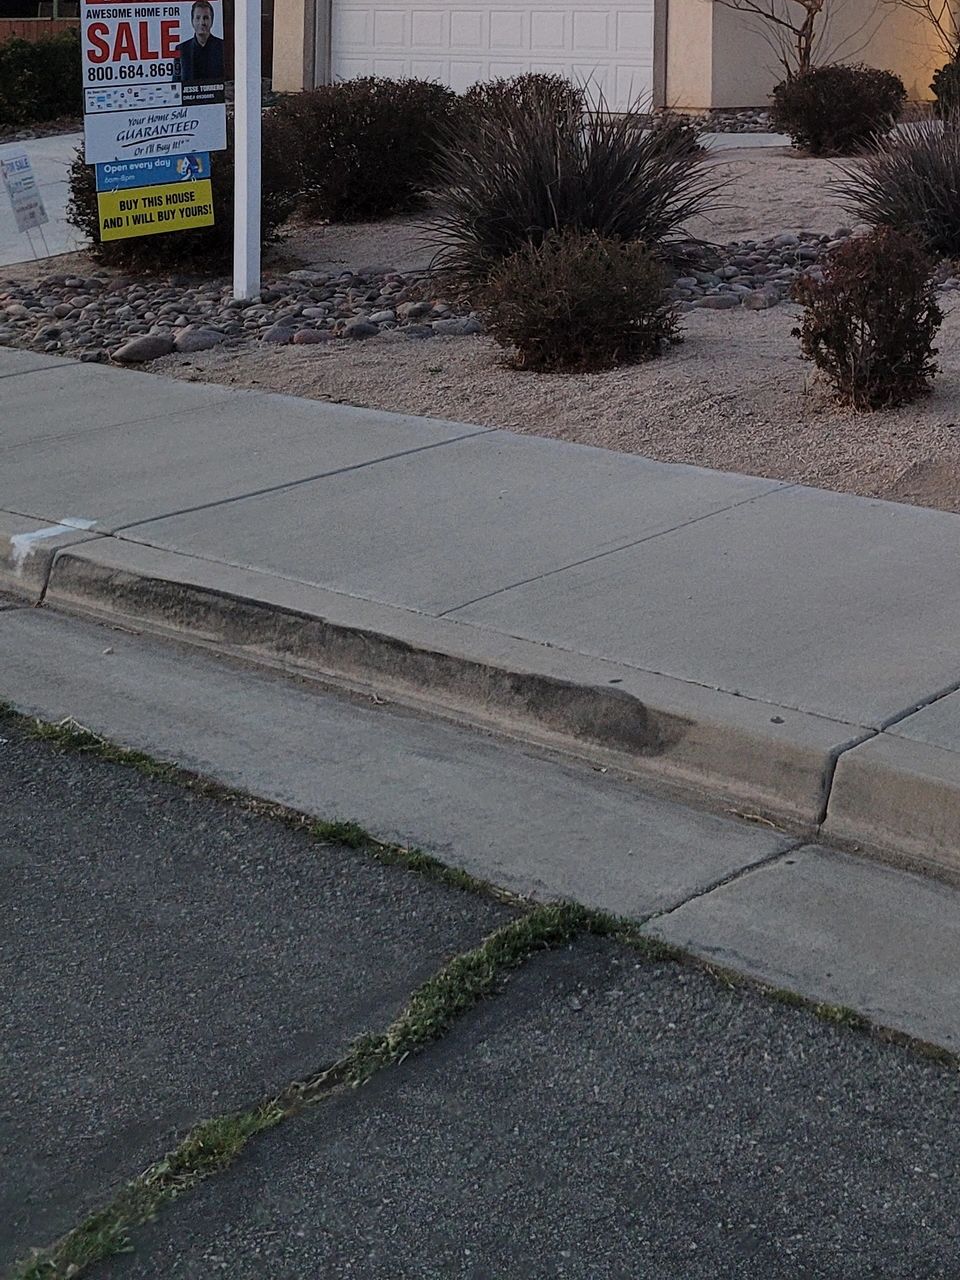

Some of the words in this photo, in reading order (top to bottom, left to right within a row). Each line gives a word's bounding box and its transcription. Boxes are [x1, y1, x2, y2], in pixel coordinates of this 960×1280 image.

[86, 8, 132, 19] AWESOME
[134, 7, 160, 18] HOME
[163, 7, 180, 17] FOR
[86, 20, 182, 64] SALE
[88, 62, 182, 81] 800.684.8699
[128, 117, 145, 127] Your
[148, 113, 169, 123] Home
[171, 108, 188, 120] Sold
[116, 120, 200, 142] GUARANTEED
[133, 147, 144, 156] Or
[156, 142, 170, 154] Buy
[103, 162, 128, 174] Open
[129, 160, 153, 170] every
[154, 158, 171, 168] day
[119, 199, 139, 211] BUY
[141, 195, 163, 208] THIS
[165, 191, 195, 205] HOUSE
[103, 217, 123, 230] AND
[131, 212, 155, 225] WILL
[157, 209, 176, 222] BUY
[179, 204, 212, 218] YOURS!
